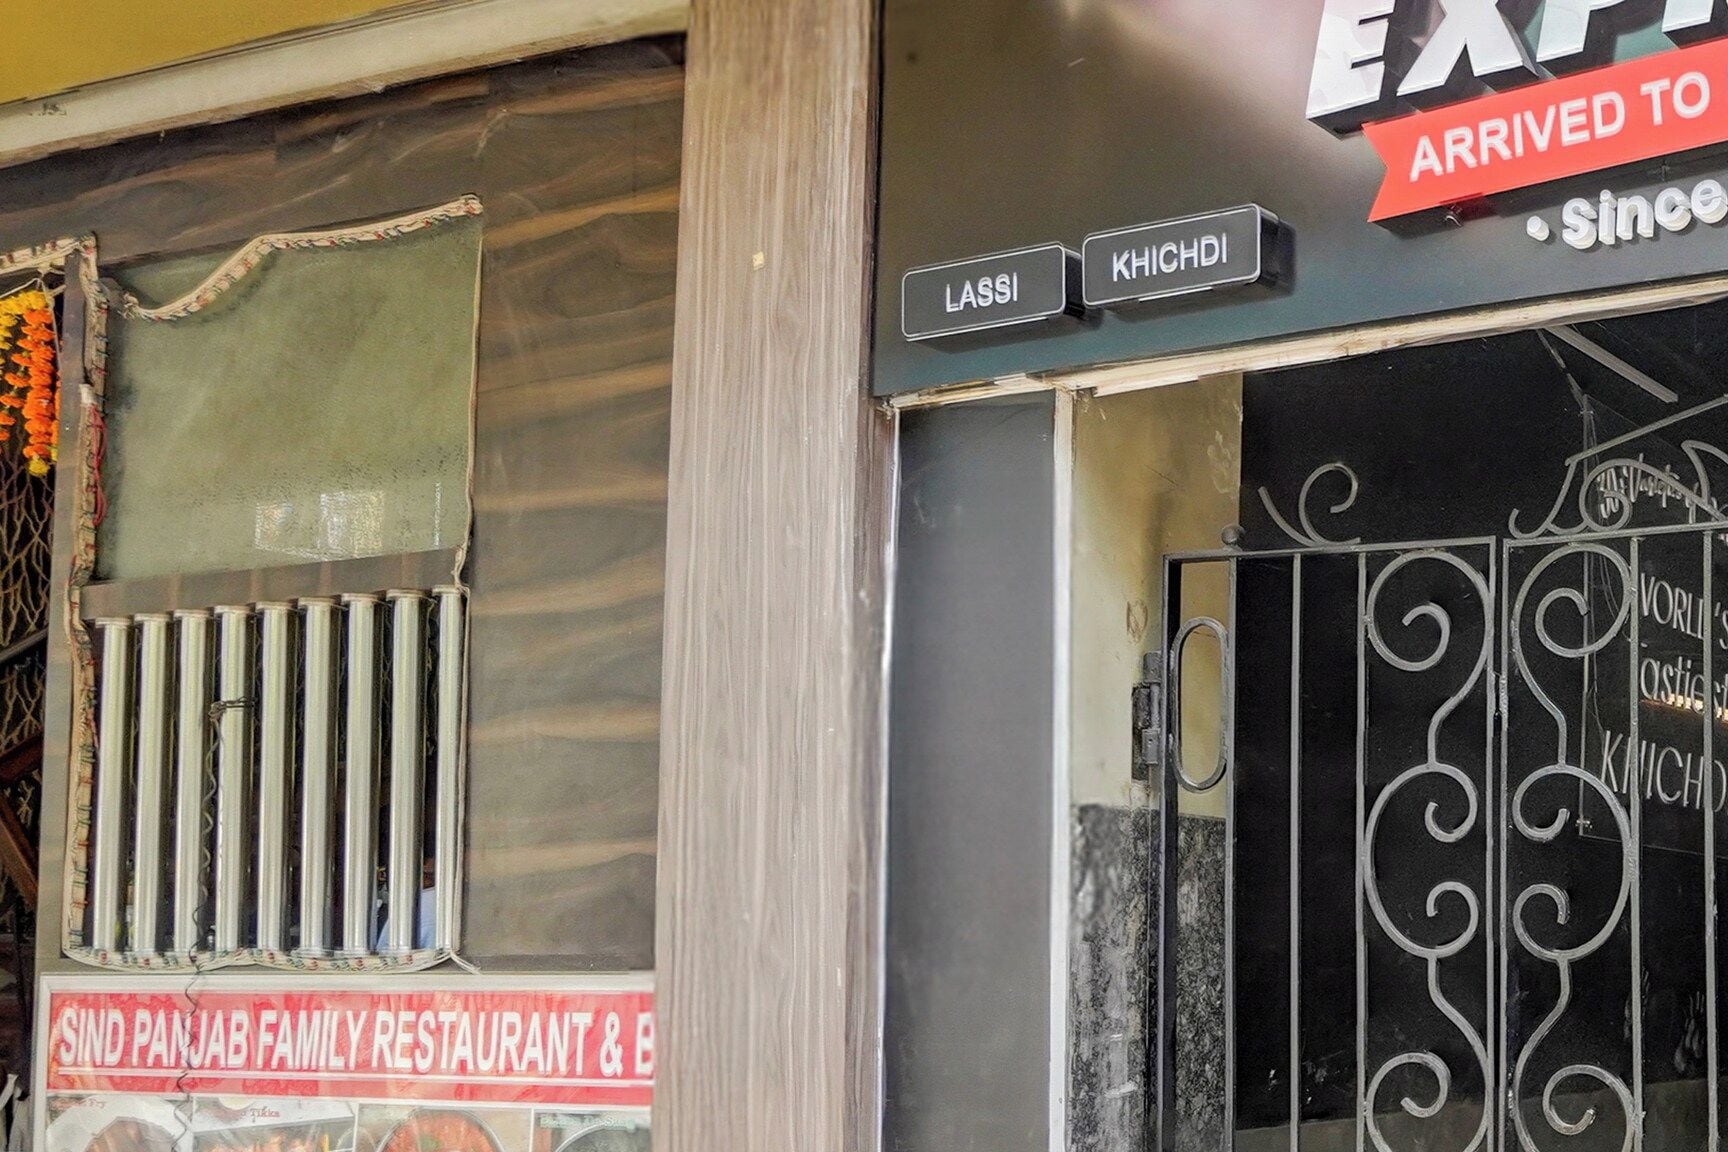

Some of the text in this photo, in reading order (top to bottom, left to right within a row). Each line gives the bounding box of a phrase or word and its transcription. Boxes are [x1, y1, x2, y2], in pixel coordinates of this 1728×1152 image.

[1408, 91, 1626, 182] ARRIVED
[1640, 72, 1710, 126] TO
[1111, 232, 1228, 282] KHICHDI
[945, 272, 1018, 314] LASSI
[59, 1006, 126, 1067] SIND
[133, 1008, 249, 1069] PANJAB
[256, 1009, 367, 1071] FAMILY
[370, 1009, 594, 1076] RESTAURANT
[599, 1011, 624, 1078] &
